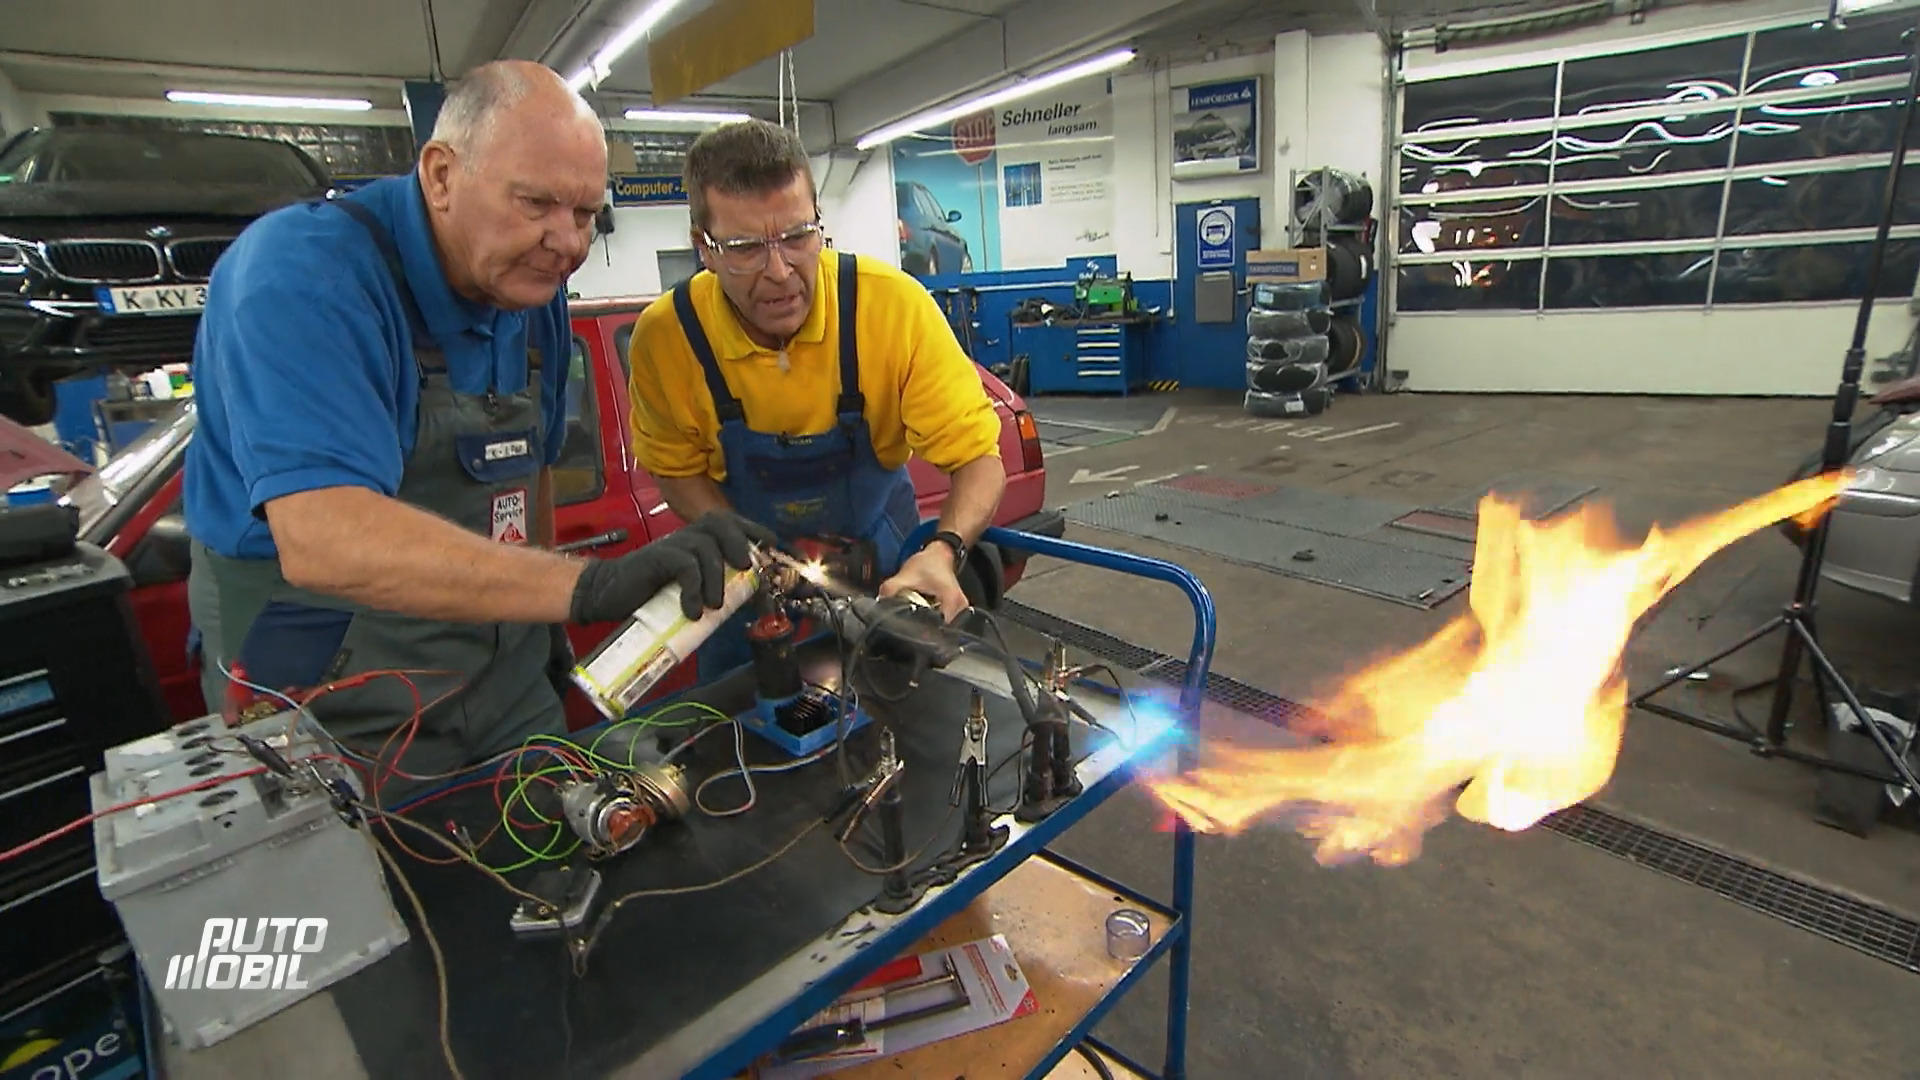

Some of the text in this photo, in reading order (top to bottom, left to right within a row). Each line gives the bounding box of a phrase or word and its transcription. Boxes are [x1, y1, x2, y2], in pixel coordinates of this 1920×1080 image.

[1002, 102, 1081, 127] Schneller
[957, 115, 995, 147] STOP
[122, 291, 141, 309] K
[156, 289, 186, 307] KY
[494, 508, 523, 523] Service
